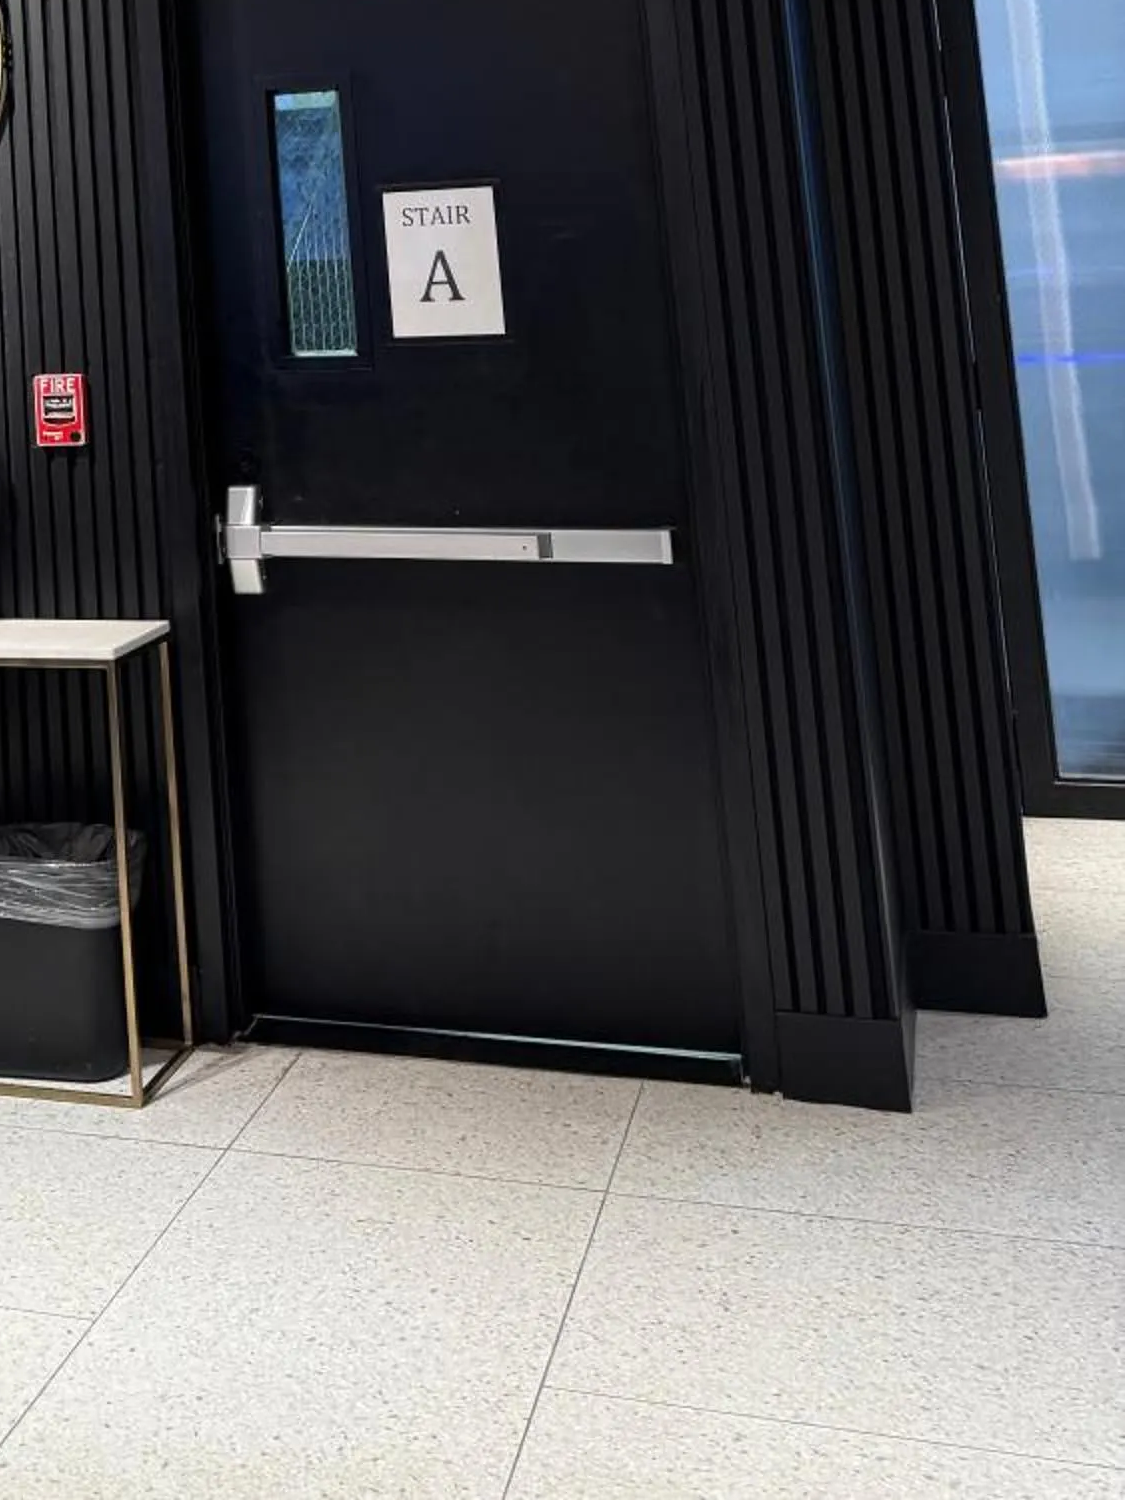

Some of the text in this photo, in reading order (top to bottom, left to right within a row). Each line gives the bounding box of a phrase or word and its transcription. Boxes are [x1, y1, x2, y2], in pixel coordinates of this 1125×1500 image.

[401, 205, 471, 228] STAIR
[419, 249, 466, 303] A
[40, 377, 77, 394] FIRE
